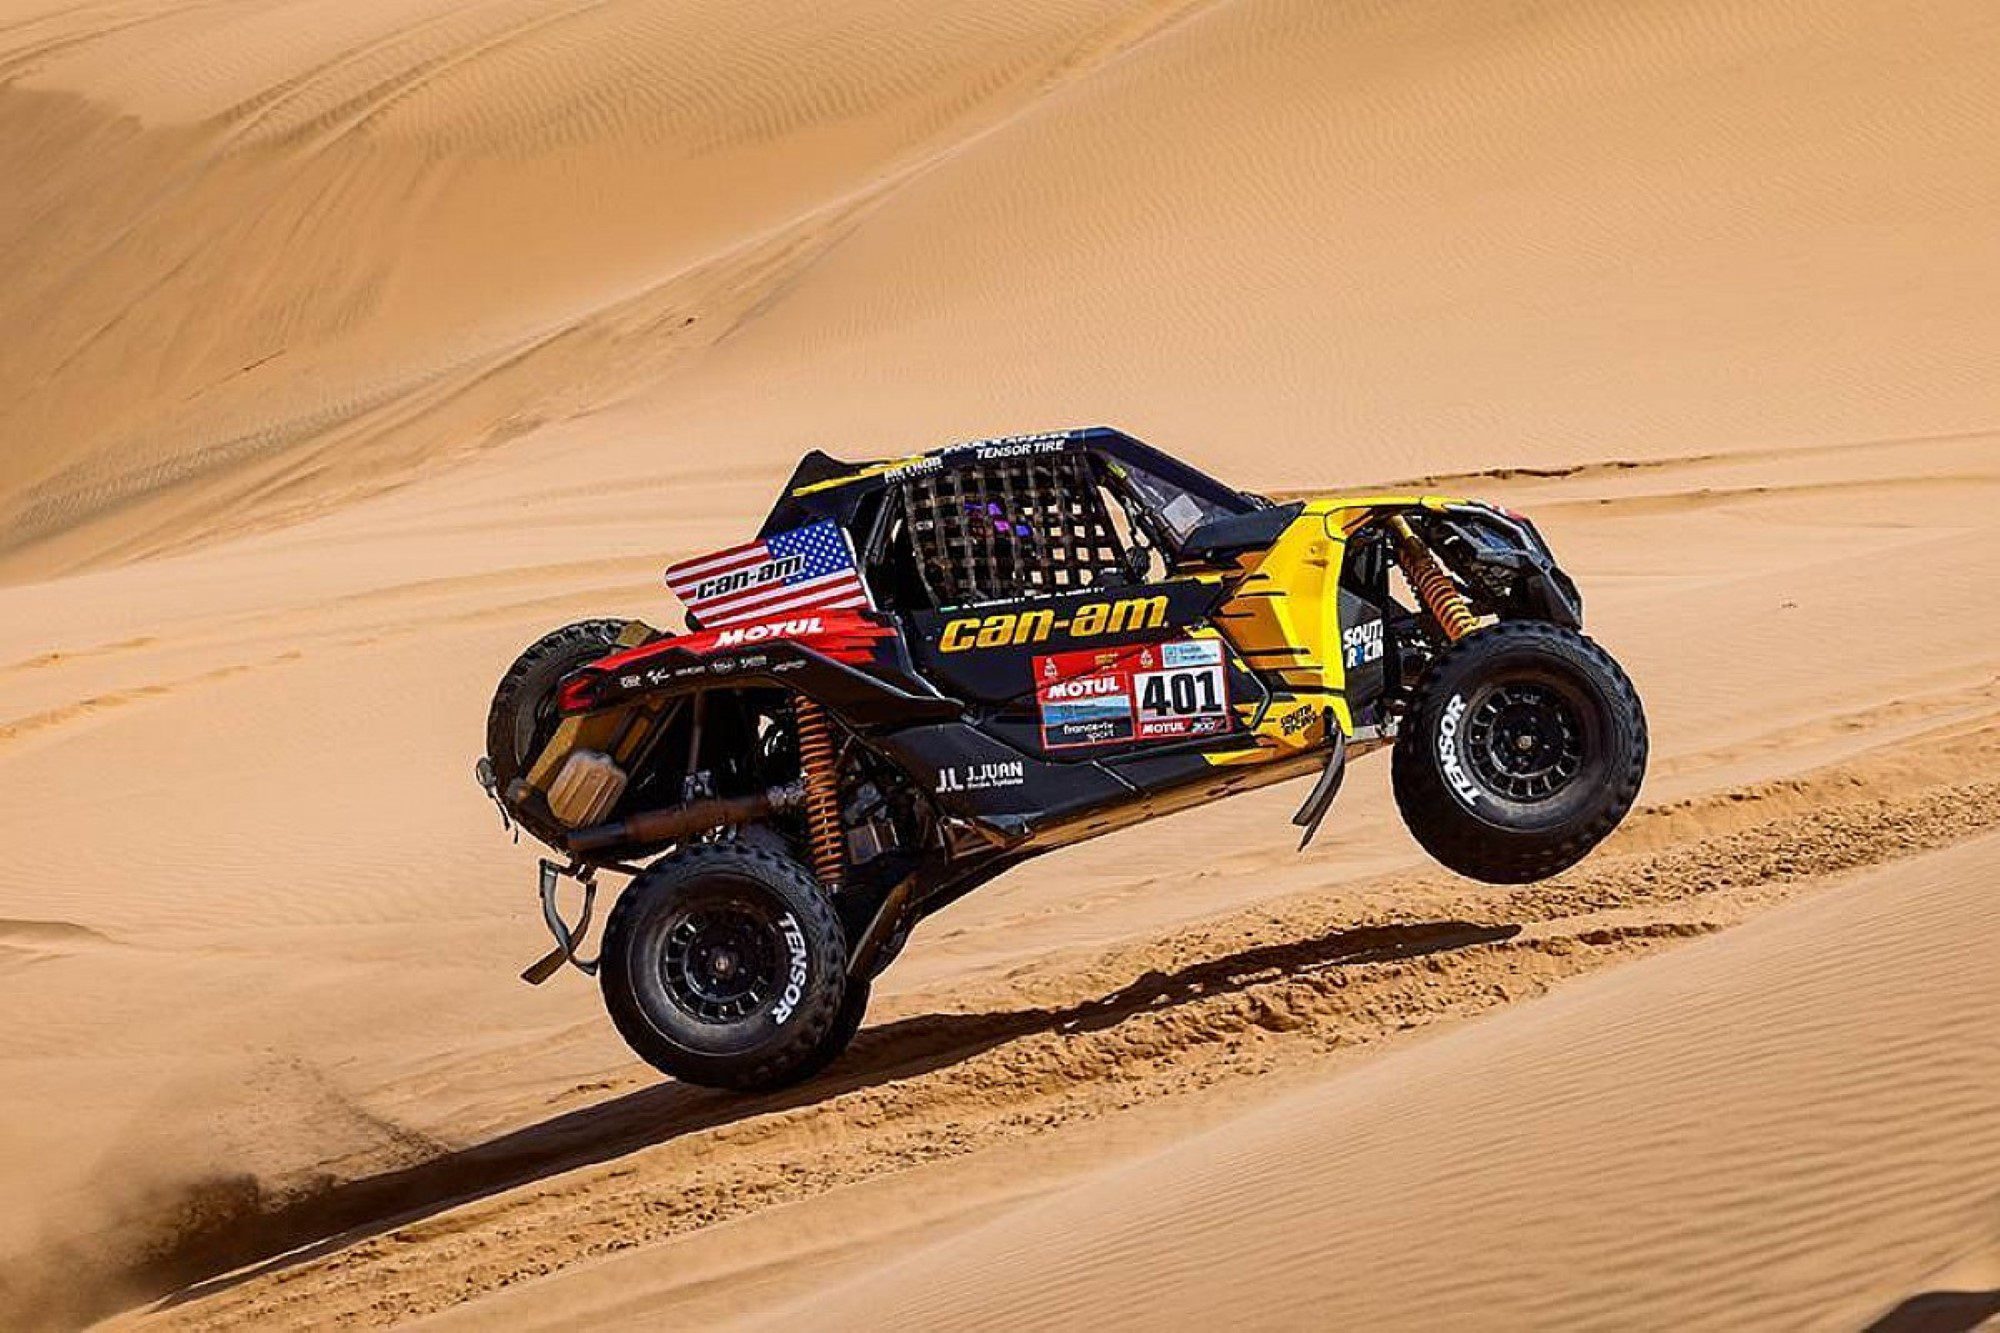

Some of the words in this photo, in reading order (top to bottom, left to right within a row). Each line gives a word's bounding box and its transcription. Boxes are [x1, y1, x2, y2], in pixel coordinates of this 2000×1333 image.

[976, 444, 1032, 460] TENSOR
[1033, 439, 1066, 453] TIRE
[697, 553, 807, 600] can-am
[713, 617, 825, 648] MOTUL
[938, 594, 1169, 653] can-am
[1048, 675, 1120, 699] MOTUL
[1142, 670, 1222, 717] 401
[1142, 721, 1187, 735] MOTUL
[1438, 693, 1483, 807] TENSOR
[771, 911, 807, 1025] TENSOR
